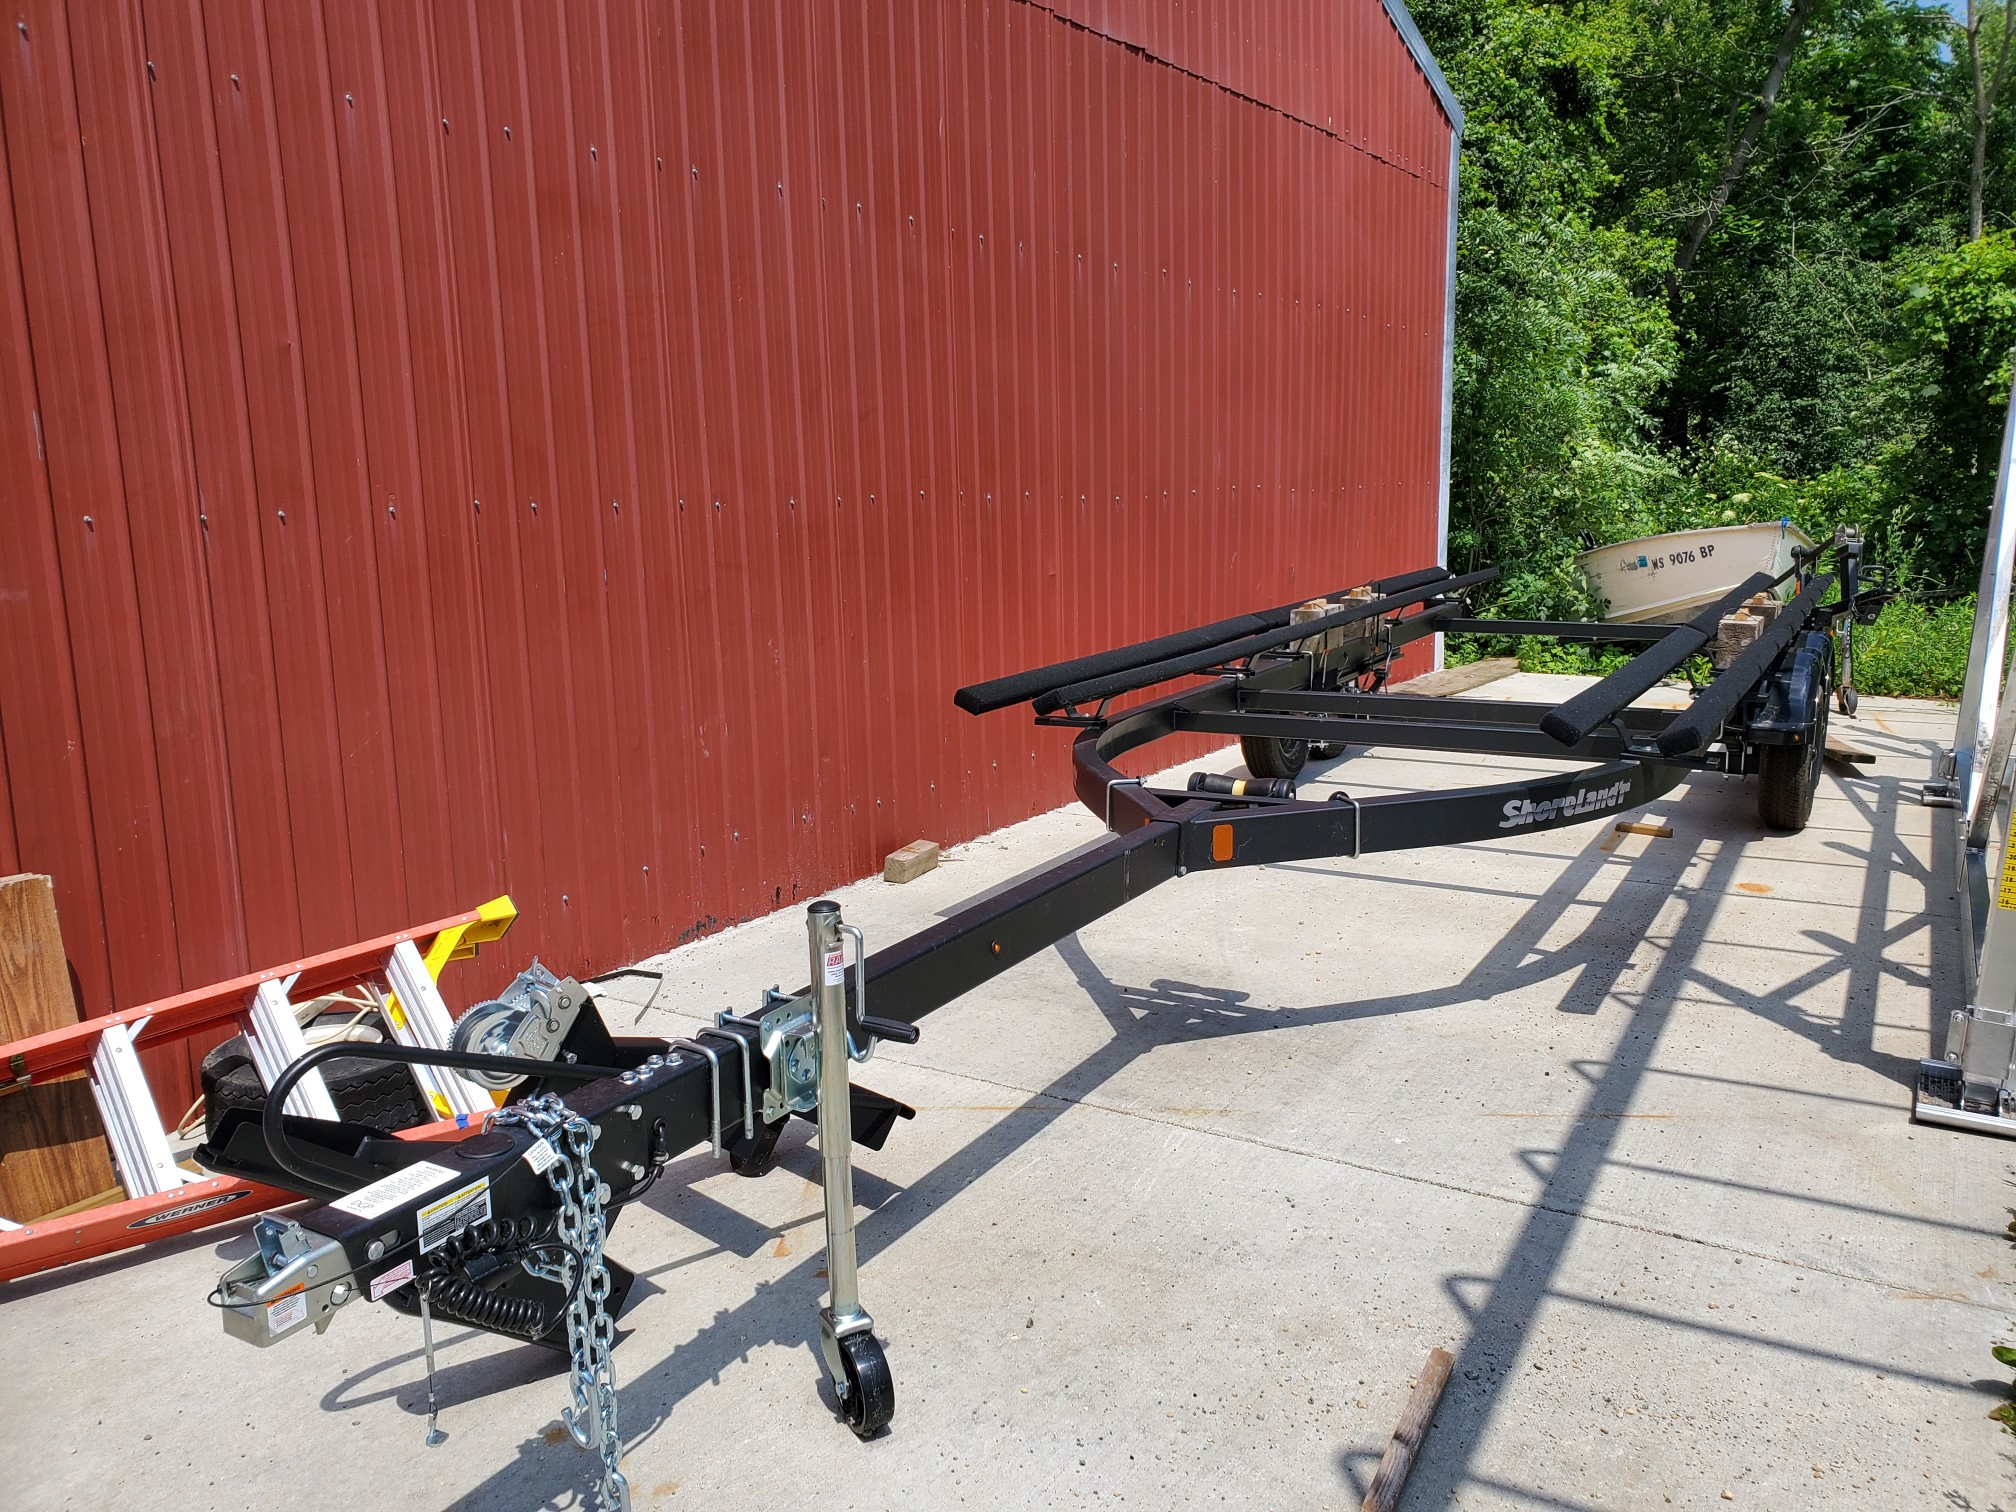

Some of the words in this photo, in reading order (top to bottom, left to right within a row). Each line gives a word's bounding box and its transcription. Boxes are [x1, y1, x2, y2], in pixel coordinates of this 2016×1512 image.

[1652, 558, 1664, 570] WS
[1669, 551, 1695, 565] 9076
[1699, 545, 1714, 558] BP
[155, 1197, 228, 1220] WERNER
[430, 1202, 448, 1213] CAUTION
